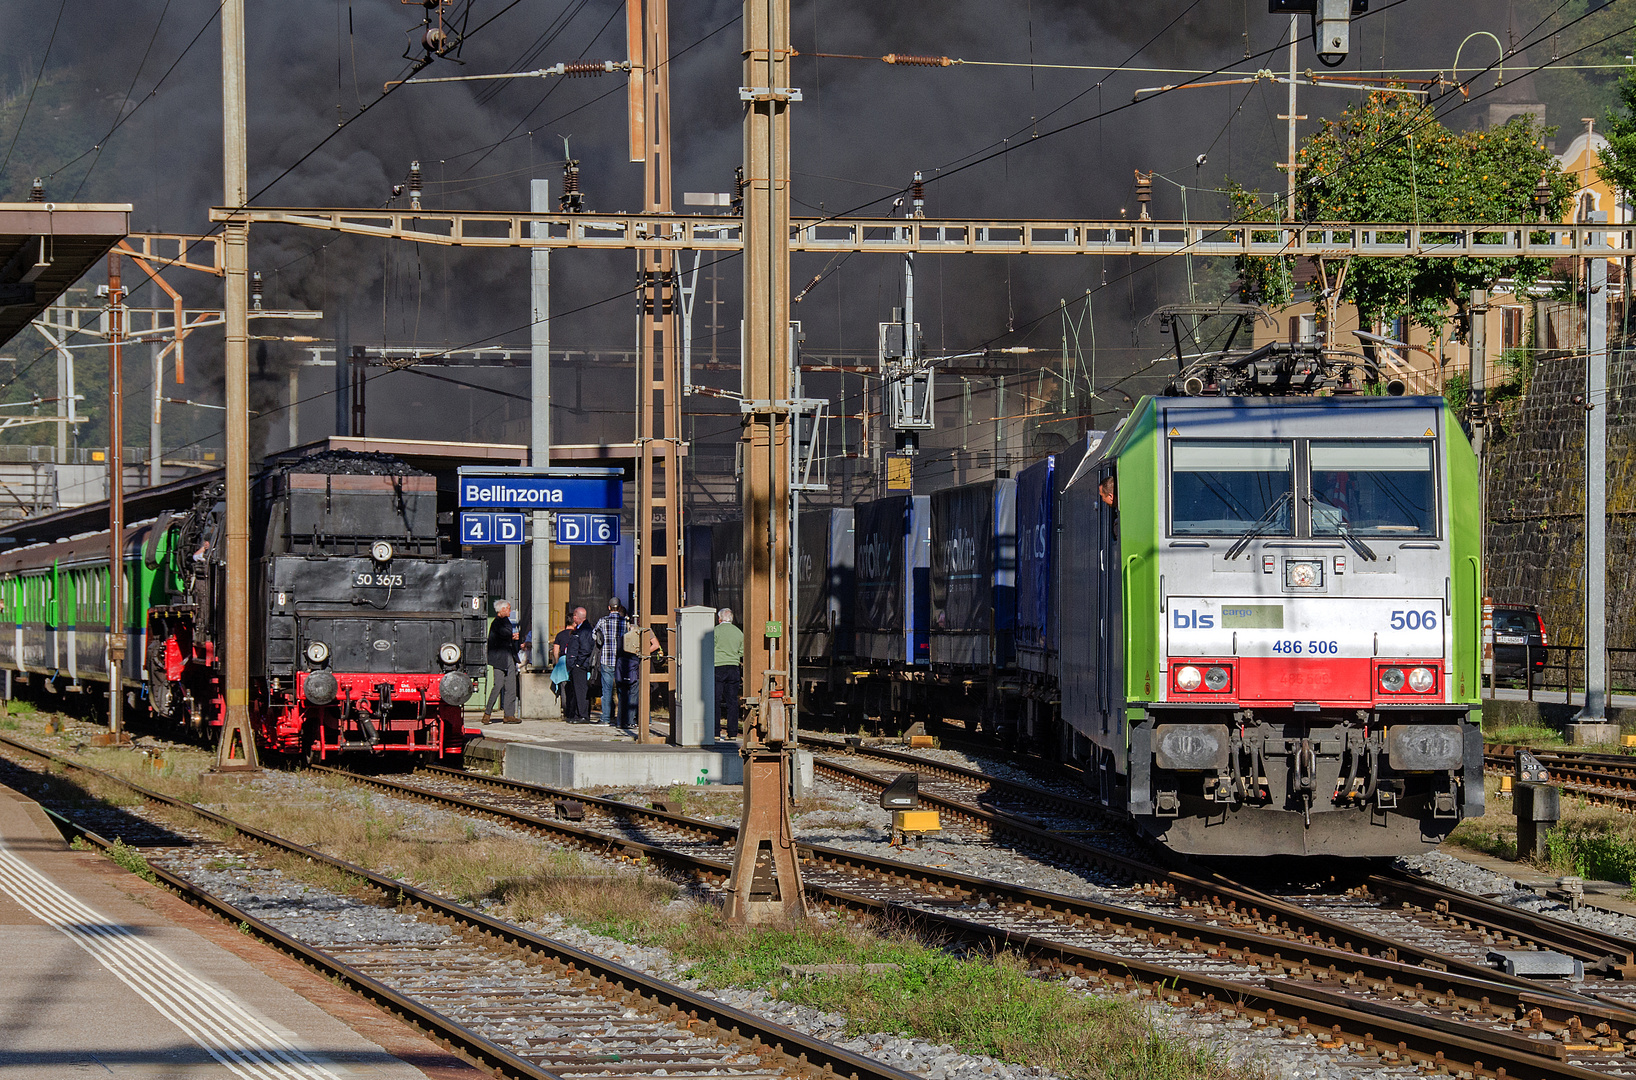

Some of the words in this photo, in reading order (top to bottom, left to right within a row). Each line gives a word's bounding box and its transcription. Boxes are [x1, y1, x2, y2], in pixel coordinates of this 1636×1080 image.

[466, 485, 563, 502] Bellinzona
[470, 522, 483, 539] 4
[502, 523, 516, 539] D
[566, 523, 580, 540] D
[598, 523, 611, 540] 6
[356, 574, 373, 585] 50
[375, 574, 403, 586] 3673
[1174, 609, 1214, 629] bls
[1222, 609, 1252, 618] cargo
[1390, 610, 1437, 630] 506
[1272, 640, 1302, 654] 486
[1308, 641, 1338, 654] 506
